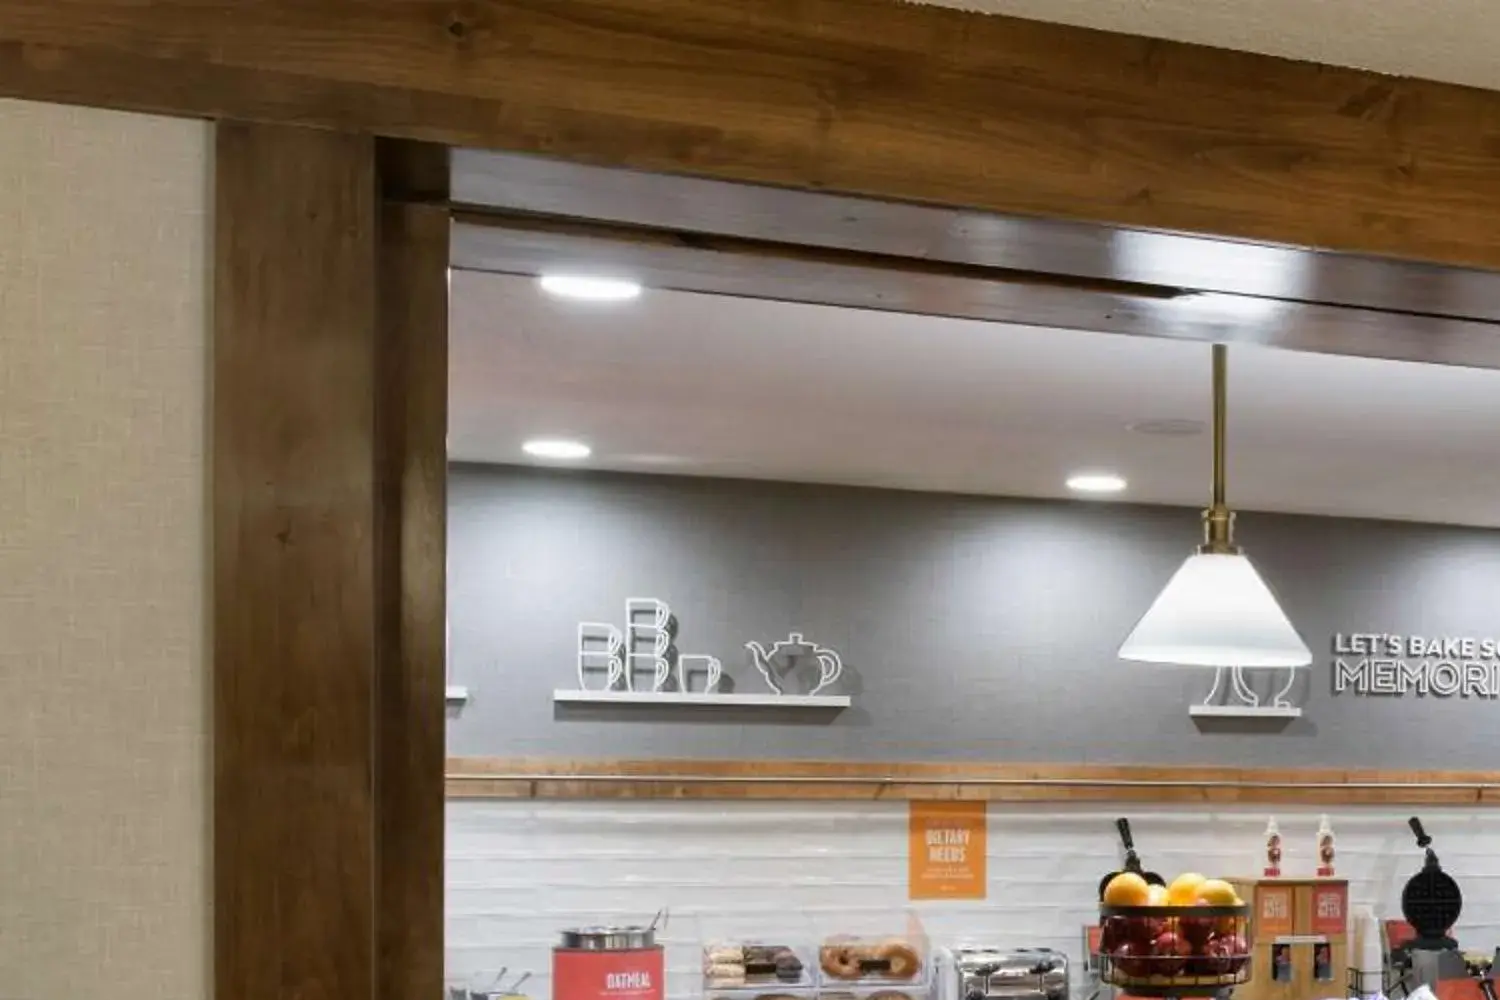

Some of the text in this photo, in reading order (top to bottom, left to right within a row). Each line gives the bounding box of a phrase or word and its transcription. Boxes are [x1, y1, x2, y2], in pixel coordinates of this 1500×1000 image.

[1335, 632, 1402, 655] LET'S
[1409, 636, 1476, 658] BAKE
[606, 972, 651, 989] OATMEAL
